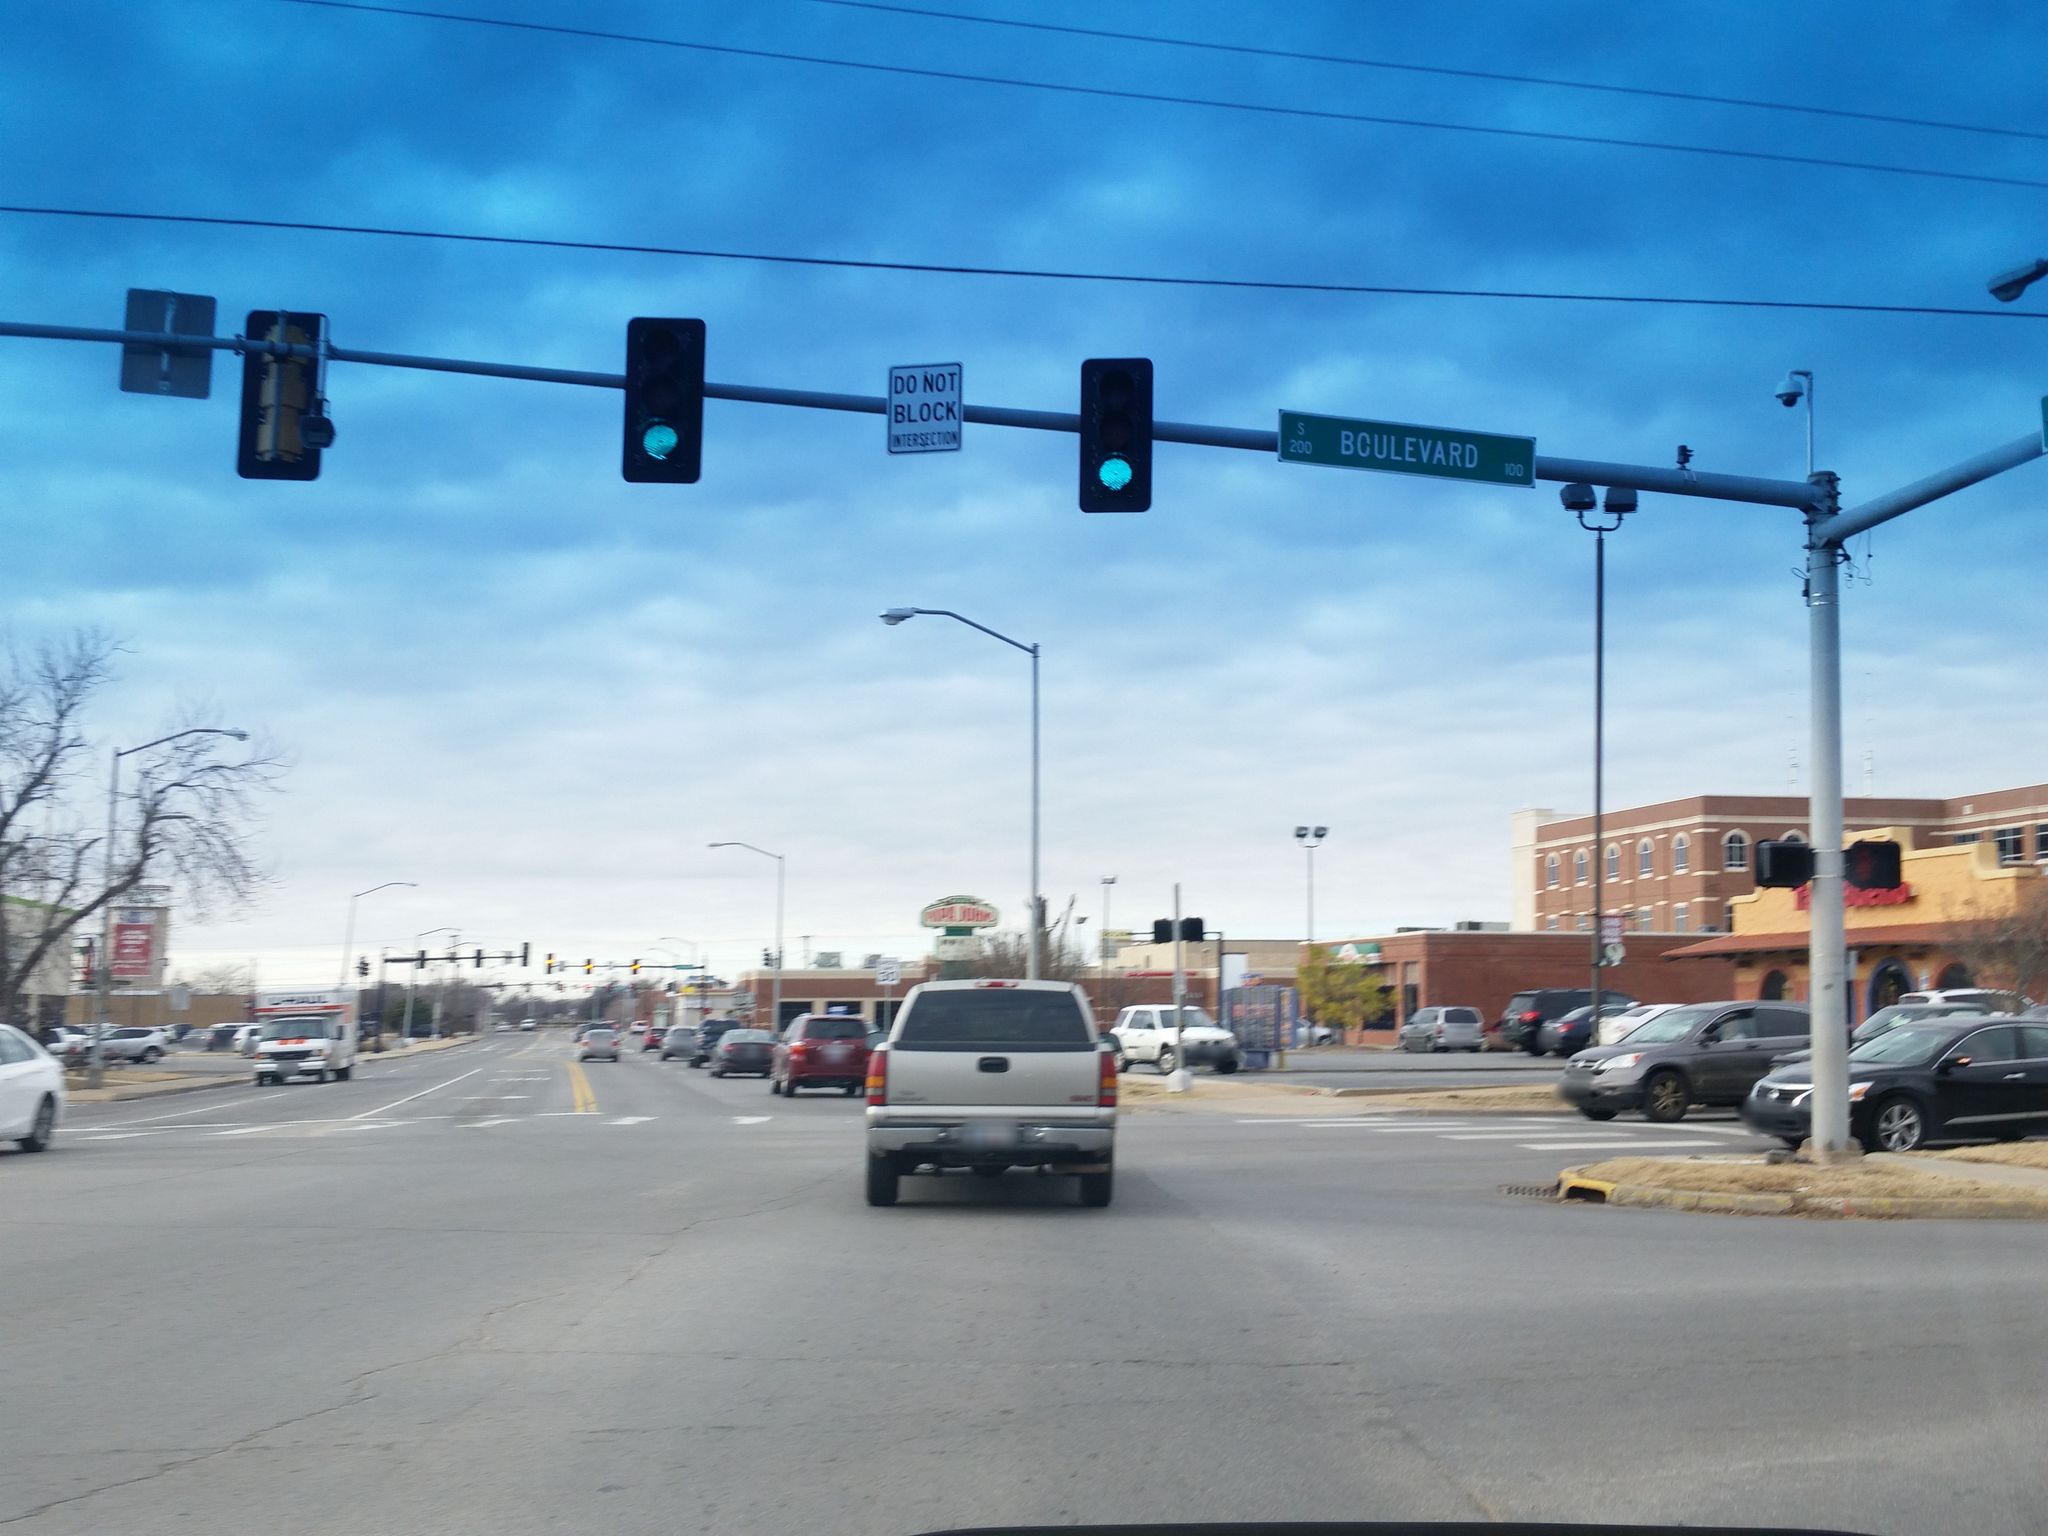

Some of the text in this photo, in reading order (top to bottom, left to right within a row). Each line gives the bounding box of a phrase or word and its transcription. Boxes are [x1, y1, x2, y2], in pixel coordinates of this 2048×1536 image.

[894, 372, 957, 394] DO NOT
[894, 402, 957, 423] BLOCK
[1297, 422, 1305, 436] S
[892, 431, 958, 447] INTERSECTION
[1289, 439, 1313, 455] 200
[1340, 430, 1478, 468] BOULEVARD
[1504, 463, 1524, 477] 100
